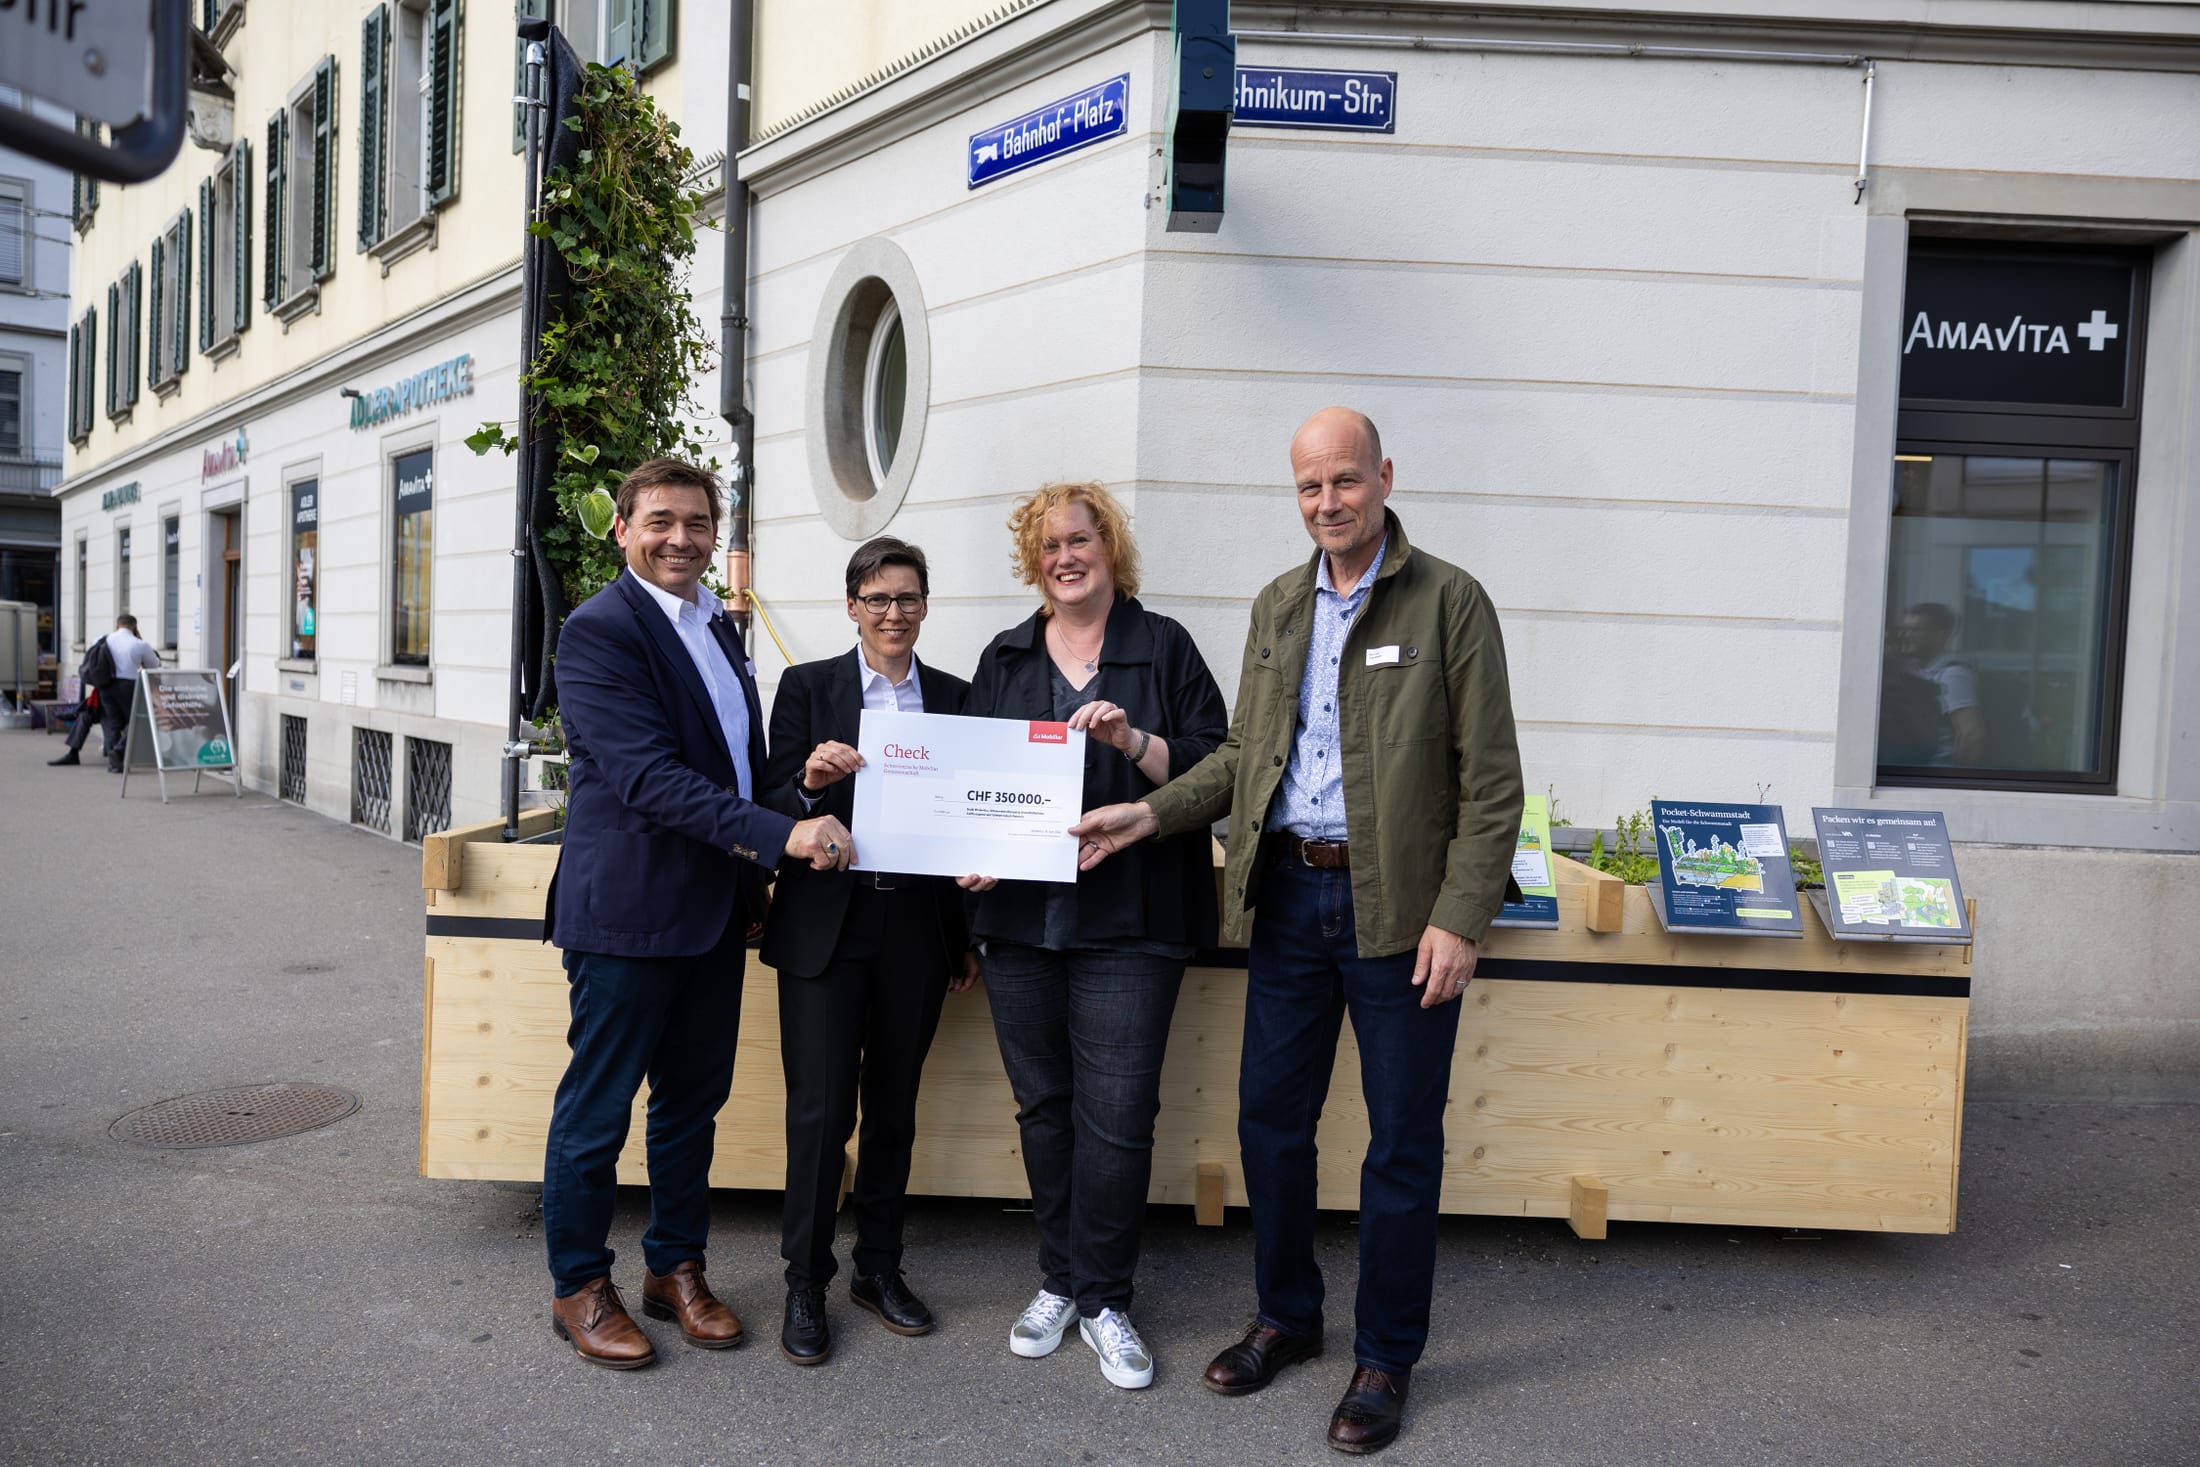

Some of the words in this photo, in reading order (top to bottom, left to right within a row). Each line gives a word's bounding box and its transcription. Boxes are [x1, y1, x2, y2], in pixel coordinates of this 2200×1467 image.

[1003, 98, 1114, 160] Bahnhof-Platz
[1904, 311, 2070, 354] AMAVITA
[350, 385, 392, 430] ADLER
[392, 353, 470, 414] APOTHEKE
[884, 743, 930, 760] Check
[967, 790, 992, 801] CHF
[1661, 808, 1751, 819] Pocket-Schwammstadt
[1822, 815, 1850, 824] Packen
[1851, 816, 1865, 824] wir
[1877, 818, 1922, 826] gemeinsam
[1924, 818, 1937, 826] an!
